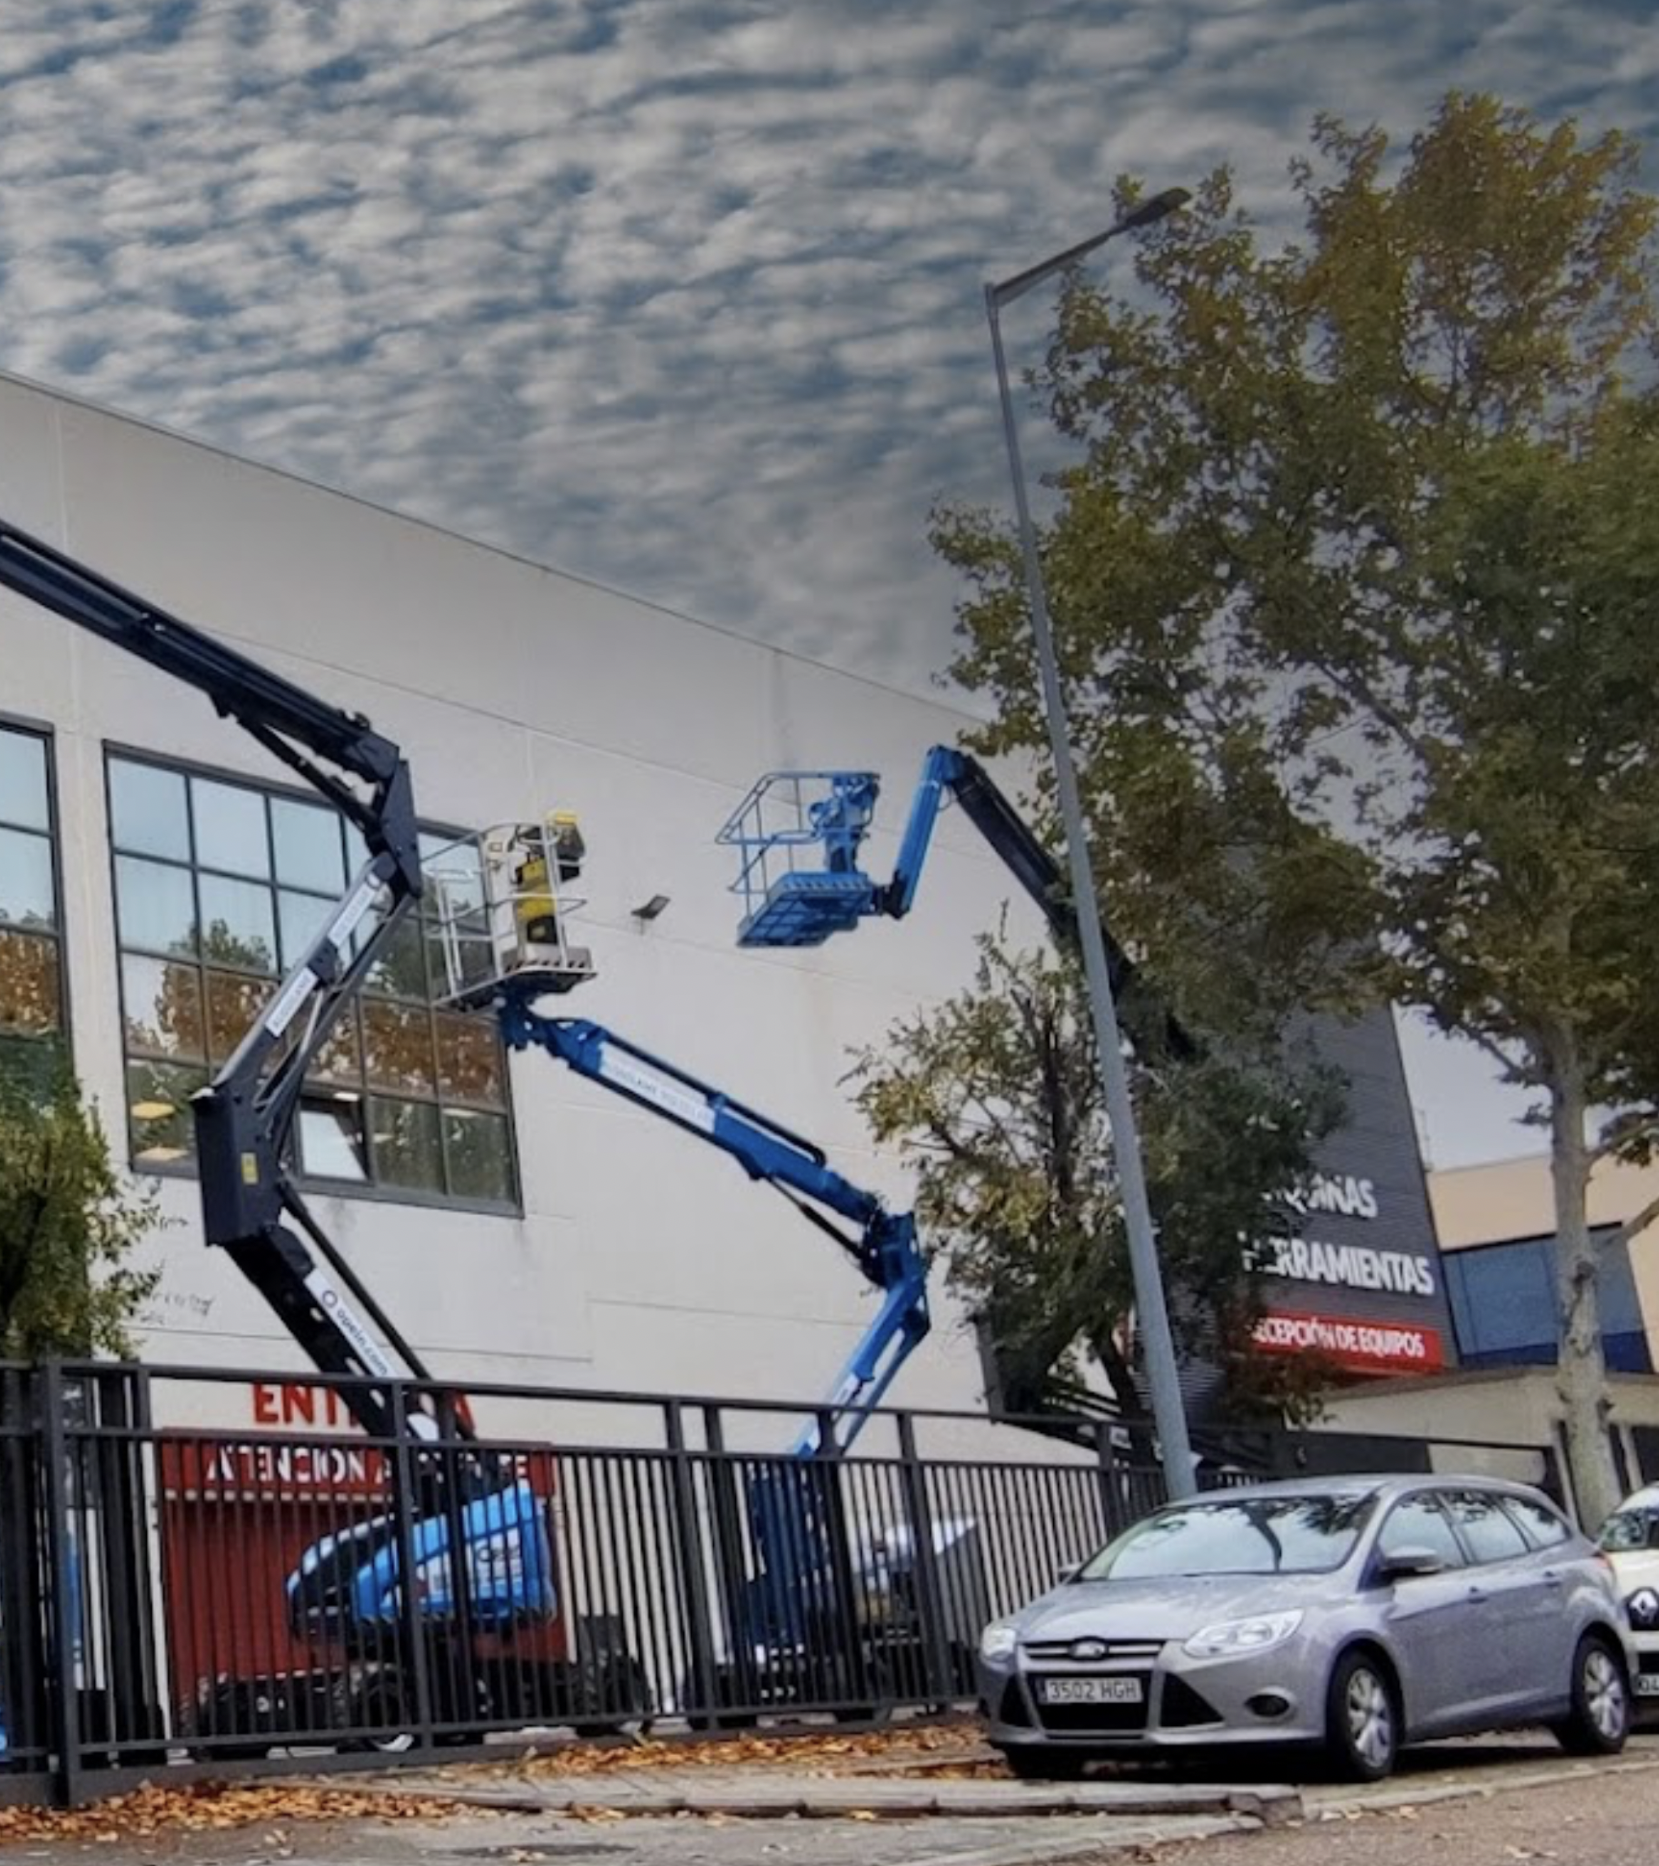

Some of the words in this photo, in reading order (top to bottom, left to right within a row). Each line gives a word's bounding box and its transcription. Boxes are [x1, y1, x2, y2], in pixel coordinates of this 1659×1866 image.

[1336, 1325, 1360, 1351] DE
[1359, 1327, 1425, 1358] EQUIPOS
[1049, 1682, 1095, 1699] 3502
[1101, 1682, 1137, 1699] HGH
